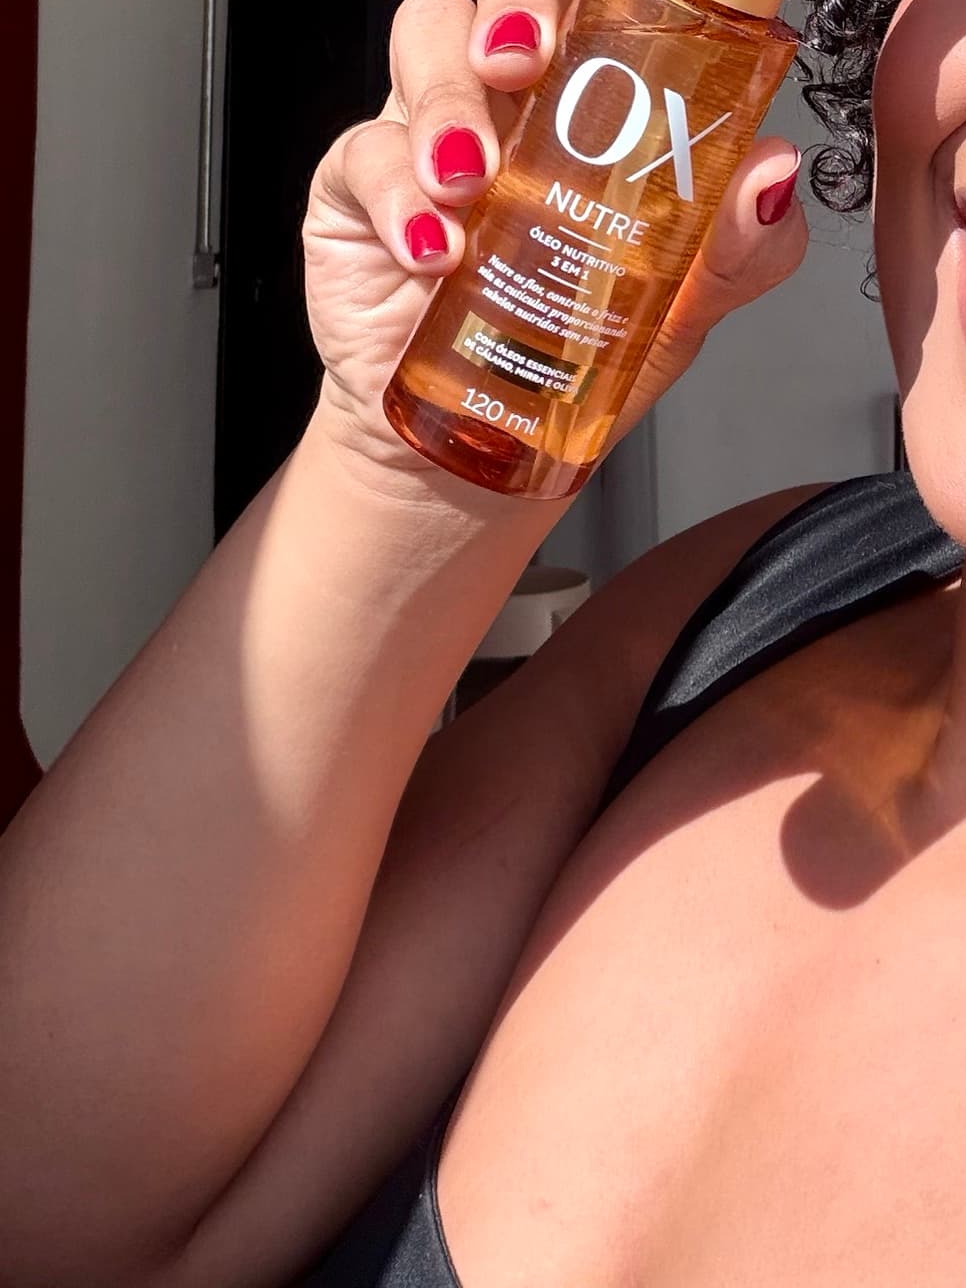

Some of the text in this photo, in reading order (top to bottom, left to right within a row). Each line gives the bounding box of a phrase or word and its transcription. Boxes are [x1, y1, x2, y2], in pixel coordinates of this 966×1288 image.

[555, 57, 732, 202] OX
[545, 181, 650, 246] NUTRE
[529, 225, 626, 277] ÓLEO NUTRITIVO
[550, 255, 590, 281] 3 EM 1
[482, 286, 517, 312] cabelos
[514, 307, 561, 334] nutridos
[558, 328, 582, 342] sem
[488, 254, 515, 277] Nutre
[513, 273, 527, 285] os
[546, 291, 592, 314] controla
[591, 308, 600, 318] o
[596, 309, 622, 323] frizz
[493, 277, 506, 289] as
[547, 308, 628, 338] proporcionando
[463, 338, 477, 351] DE
[475, 346, 514, 373] CÁLAMO,
[514, 367, 545, 386] MIRRA
[544, 379, 553, 388] E
[474, 332, 577, 382] COM ÓLEOS ESSENCIAIS
[460, 388, 541, 436] 120 ml
